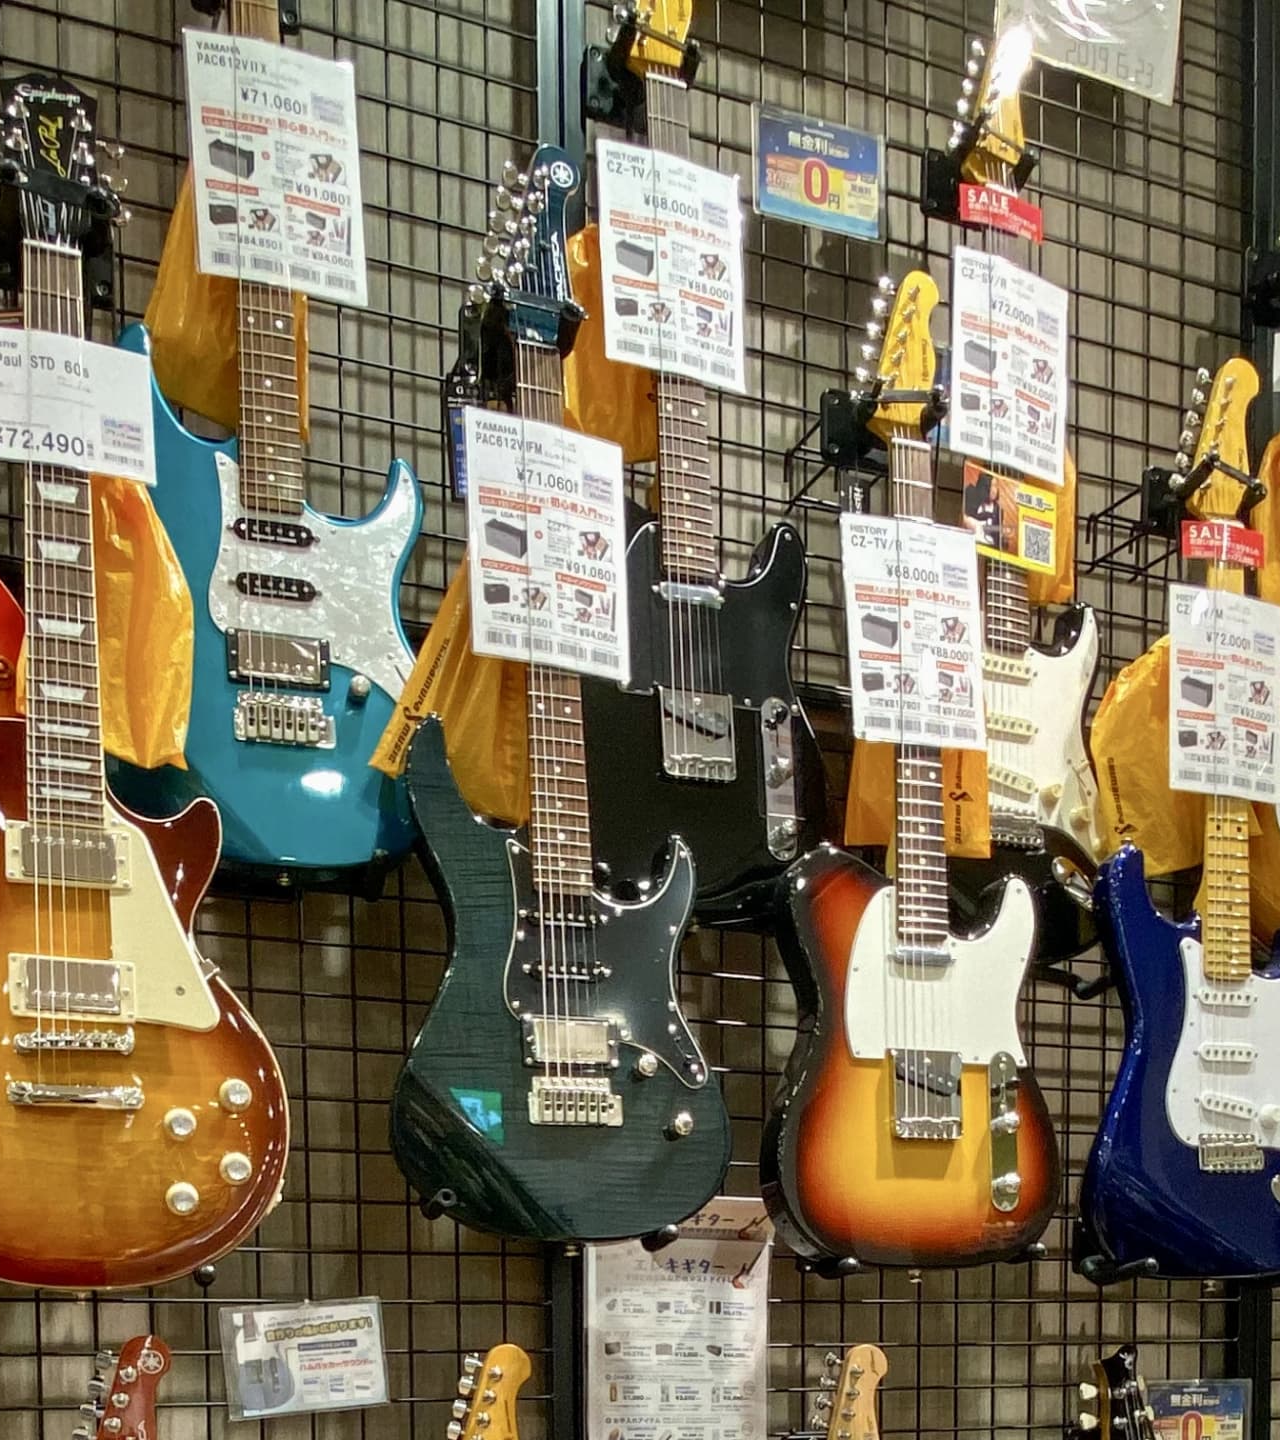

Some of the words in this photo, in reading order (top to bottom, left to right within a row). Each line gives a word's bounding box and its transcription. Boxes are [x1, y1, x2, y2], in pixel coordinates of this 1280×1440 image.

[197, 41, 240, 55] YAMAHA
[966, 188, 1010, 210] SALE
[30, 354, 56, 371] STD
[475, 420, 518, 436] YAMAHA
[1189, 525, 1231, 543] SALE
